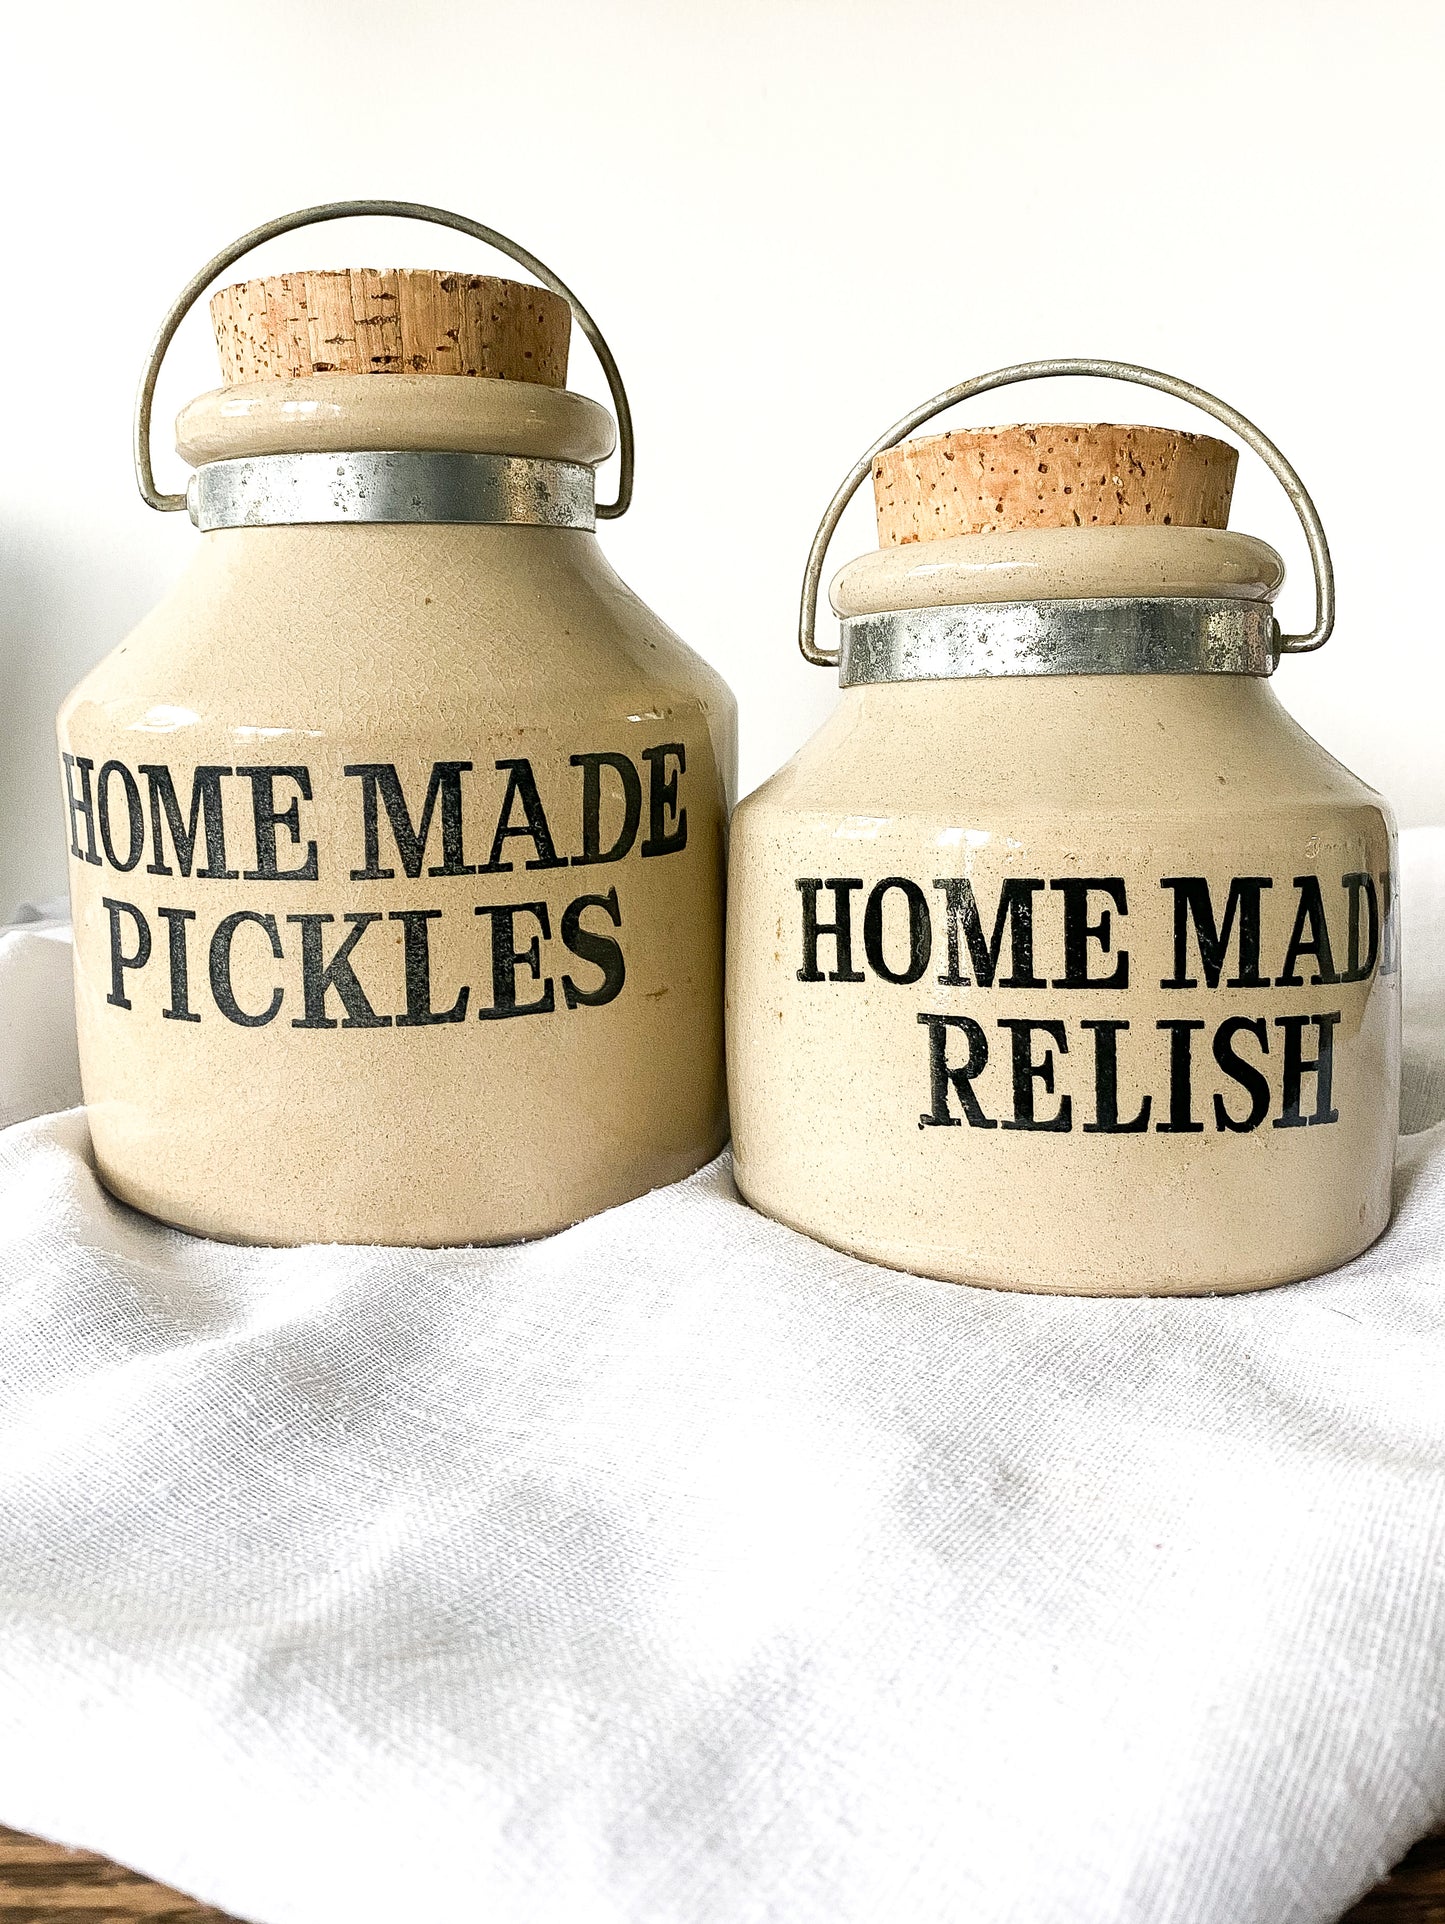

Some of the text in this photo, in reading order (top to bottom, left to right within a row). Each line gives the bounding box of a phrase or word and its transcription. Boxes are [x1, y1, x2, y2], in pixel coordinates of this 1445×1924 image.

[62, 743, 687, 881] HOME MADE
[103, 887, 626, 1029] PICKLES
[795, 876, 1130, 990] HOME
[917, 1012, 1341, 1134] RELISH
